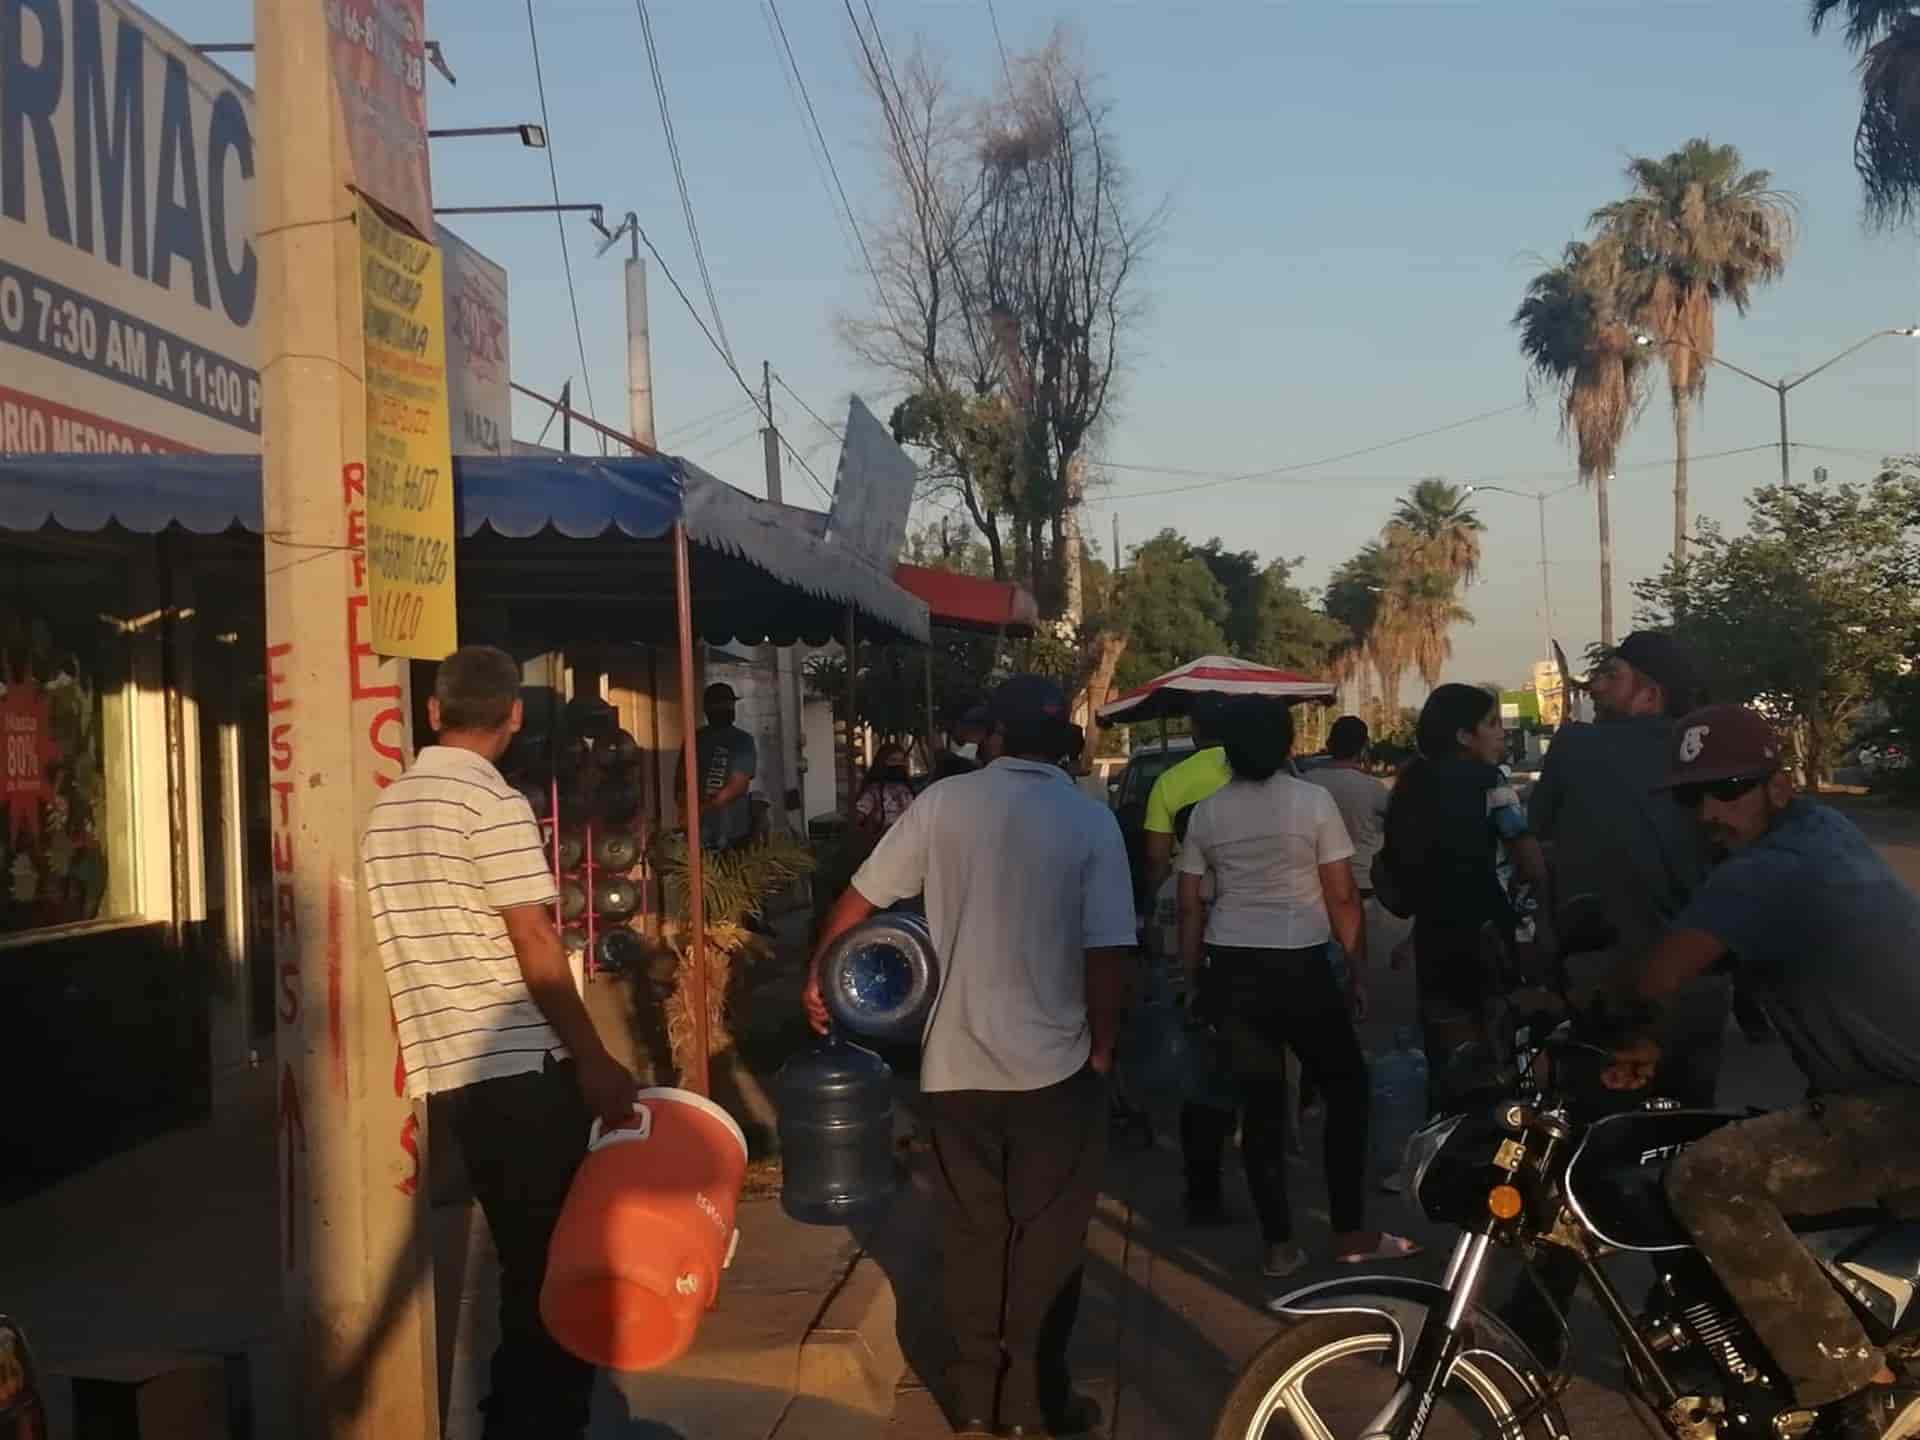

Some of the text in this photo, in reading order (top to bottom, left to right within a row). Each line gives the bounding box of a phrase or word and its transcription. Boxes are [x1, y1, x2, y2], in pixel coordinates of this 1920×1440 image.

[33, 287, 97, 361] 7:30
[105, 319, 148, 381] AM
[155, 340, 175, 391] A
[180, 351, 242, 417] 11:00
